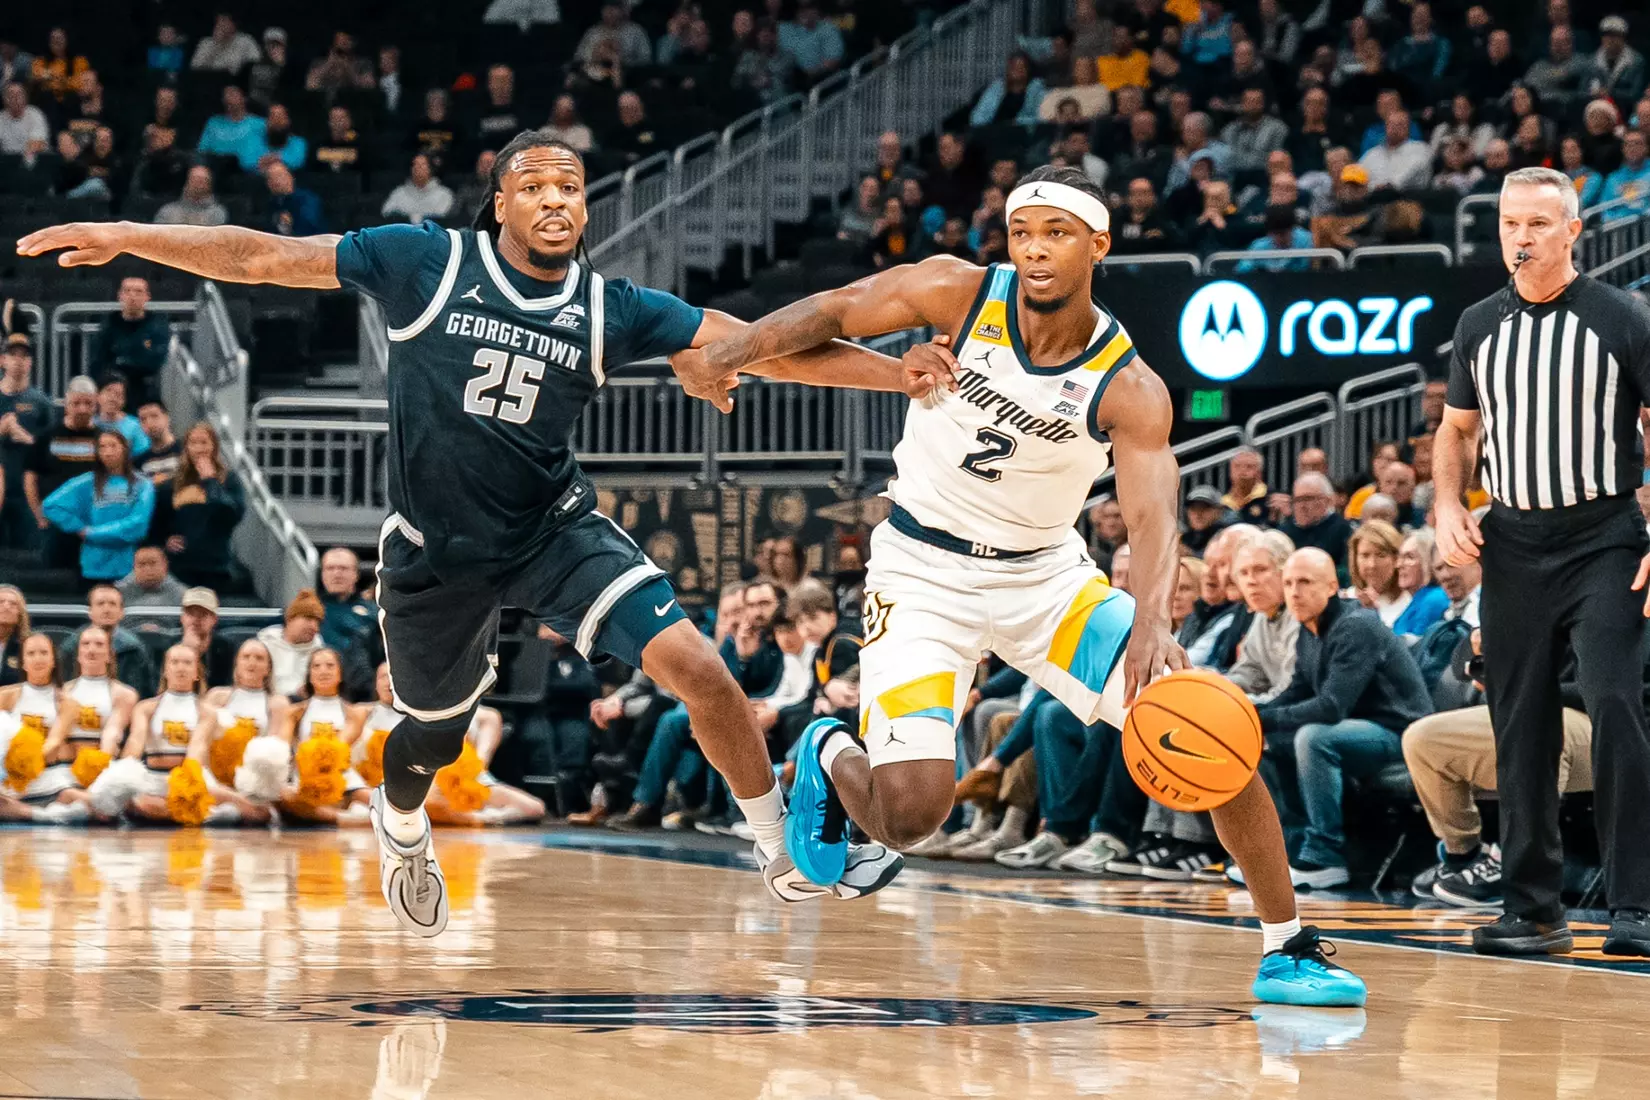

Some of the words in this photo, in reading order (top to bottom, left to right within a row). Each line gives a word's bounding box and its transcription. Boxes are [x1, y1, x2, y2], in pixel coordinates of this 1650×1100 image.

[445, 312, 582, 371] GEORGETOWN
[1279, 295, 1433, 357] razr
[463, 348, 546, 424] 25
[948, 367, 1079, 444] Marquette
[1053, 404, 1080, 417] EAST
[1059, 400, 1078, 411] BIG
[958, 426, 1018, 483] 2
[1136, 758, 1200, 805] ELITE
